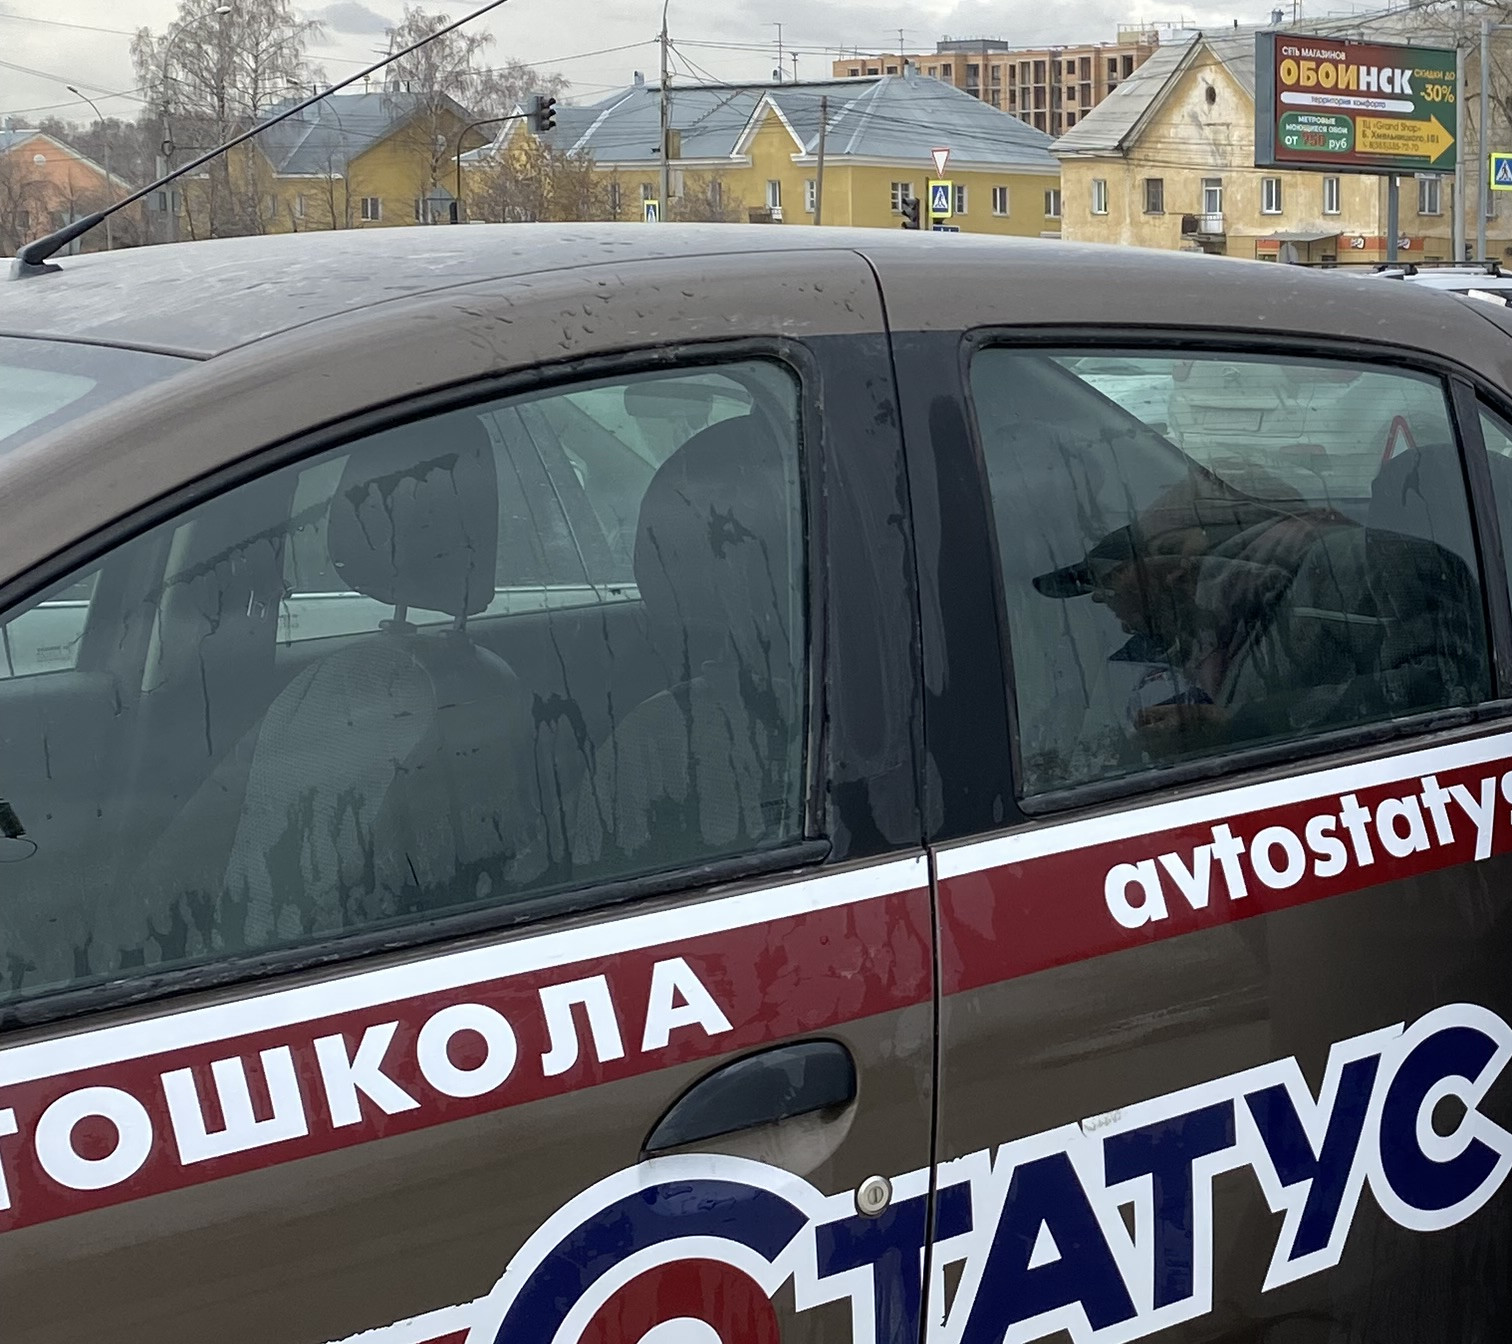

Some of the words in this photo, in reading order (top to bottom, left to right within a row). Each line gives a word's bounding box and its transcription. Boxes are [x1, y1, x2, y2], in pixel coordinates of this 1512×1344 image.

[1282, 46, 1300, 56] СЕТЬ
[1301, 48, 1346, 60] МАГАЗИНОВ
[1280, 58, 1413, 95] ОБОИНСК
[1420, 84, 1455, 103] -30%
[1328, 137, 1348, 150] руб
[0, 957, 734, 1210] ОШКОЛА
